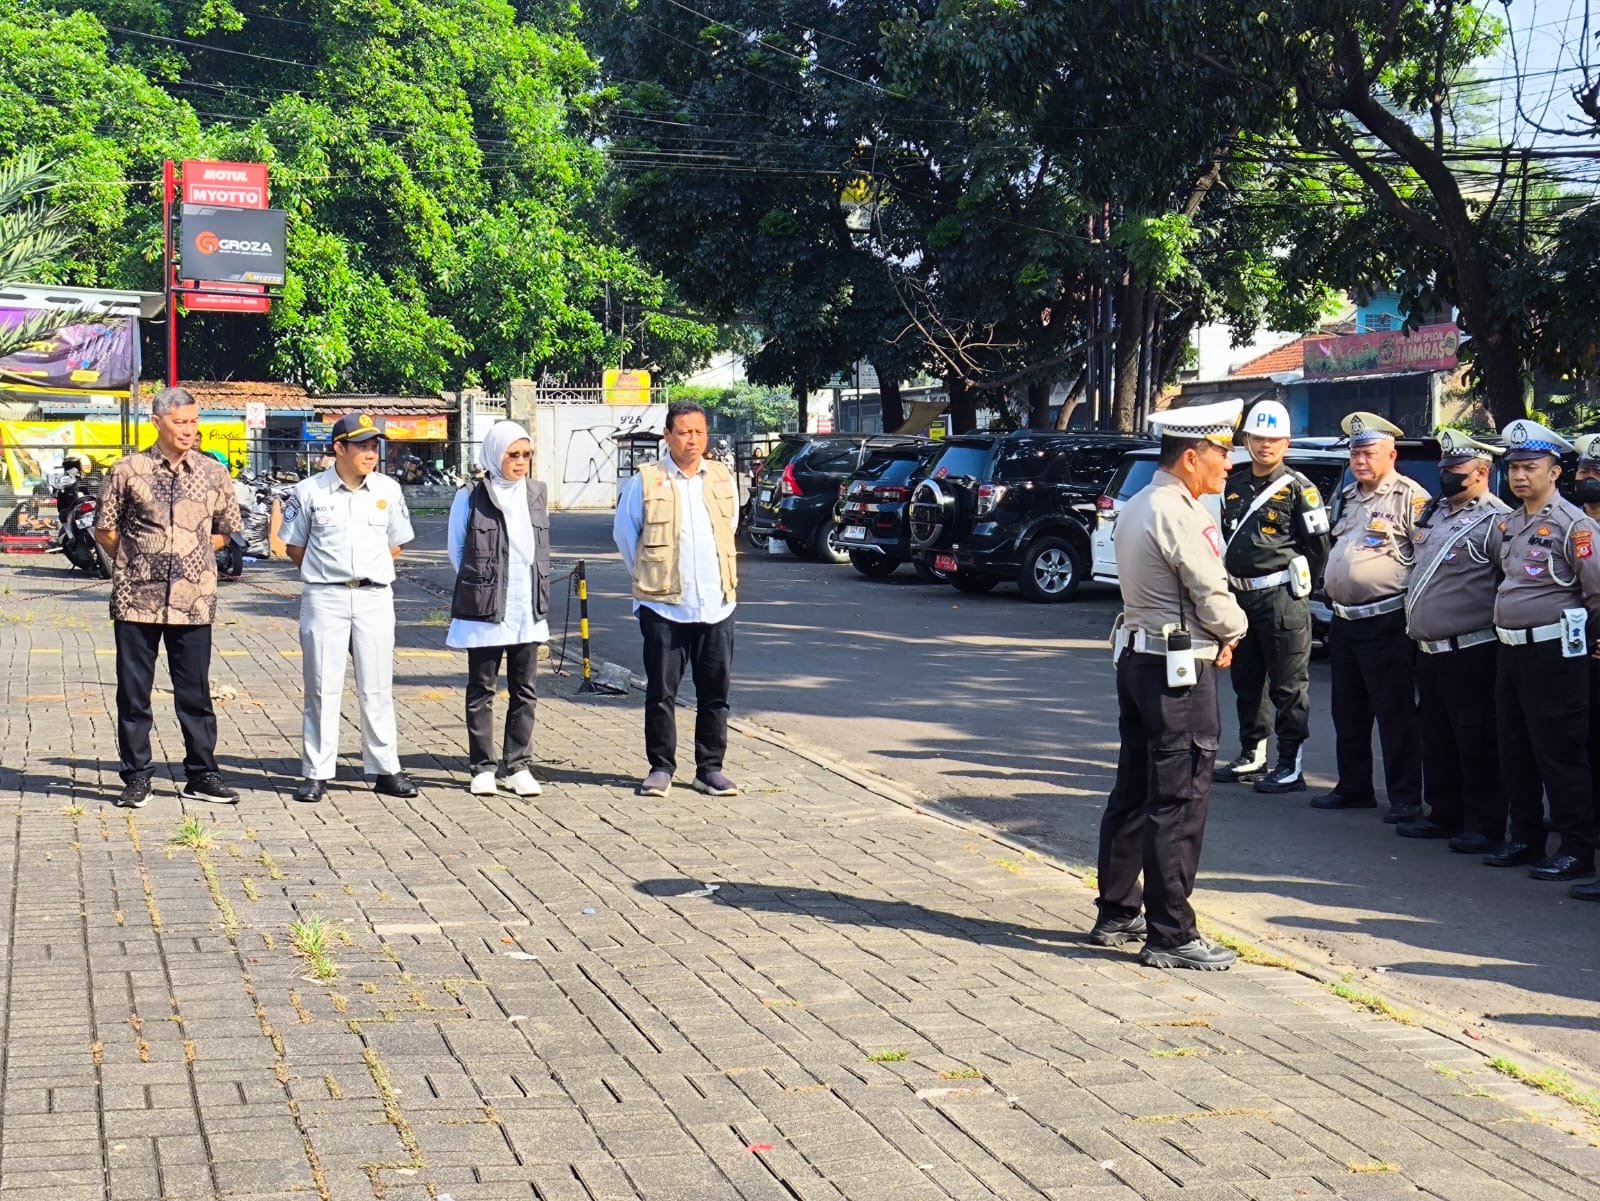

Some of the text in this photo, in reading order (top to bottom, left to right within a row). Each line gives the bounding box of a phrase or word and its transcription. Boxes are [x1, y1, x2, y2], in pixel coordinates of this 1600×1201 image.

[203, 169, 248, 182] MOTUL
[193, 189, 258, 204] MYOTTO
[218, 238, 273, 253] GROZA
[1256, 412, 1277, 429] PM
